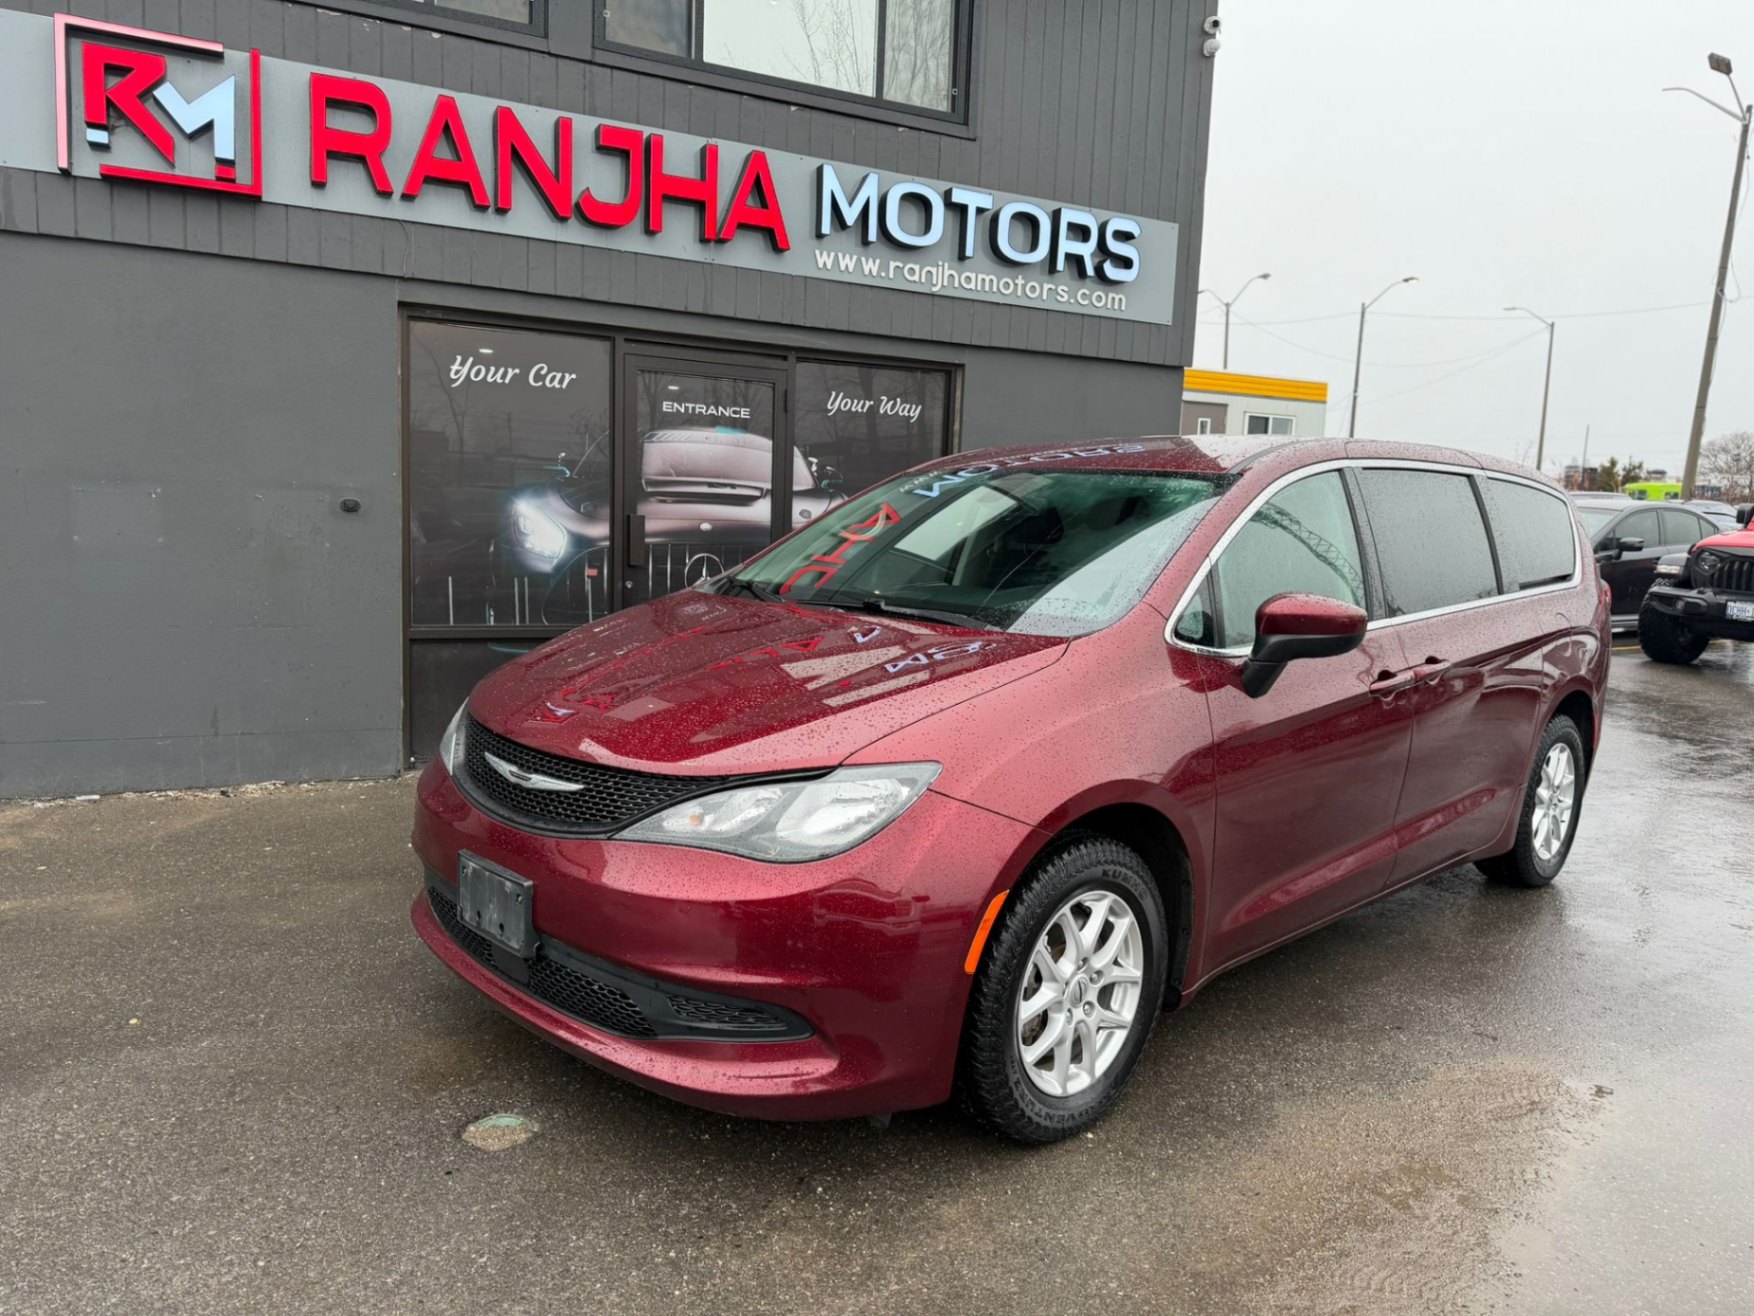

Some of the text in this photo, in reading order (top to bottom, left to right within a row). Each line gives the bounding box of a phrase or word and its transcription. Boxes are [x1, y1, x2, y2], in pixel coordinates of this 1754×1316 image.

[310, 72, 1142, 284] RANJHA MOTORS
[814, 249, 1127, 311] www.ranjhamotors.com
[449, 355, 577, 389] Your Car
[662, 401, 751, 419] ENTRANCE
[826, 391, 922, 423] Your Way
